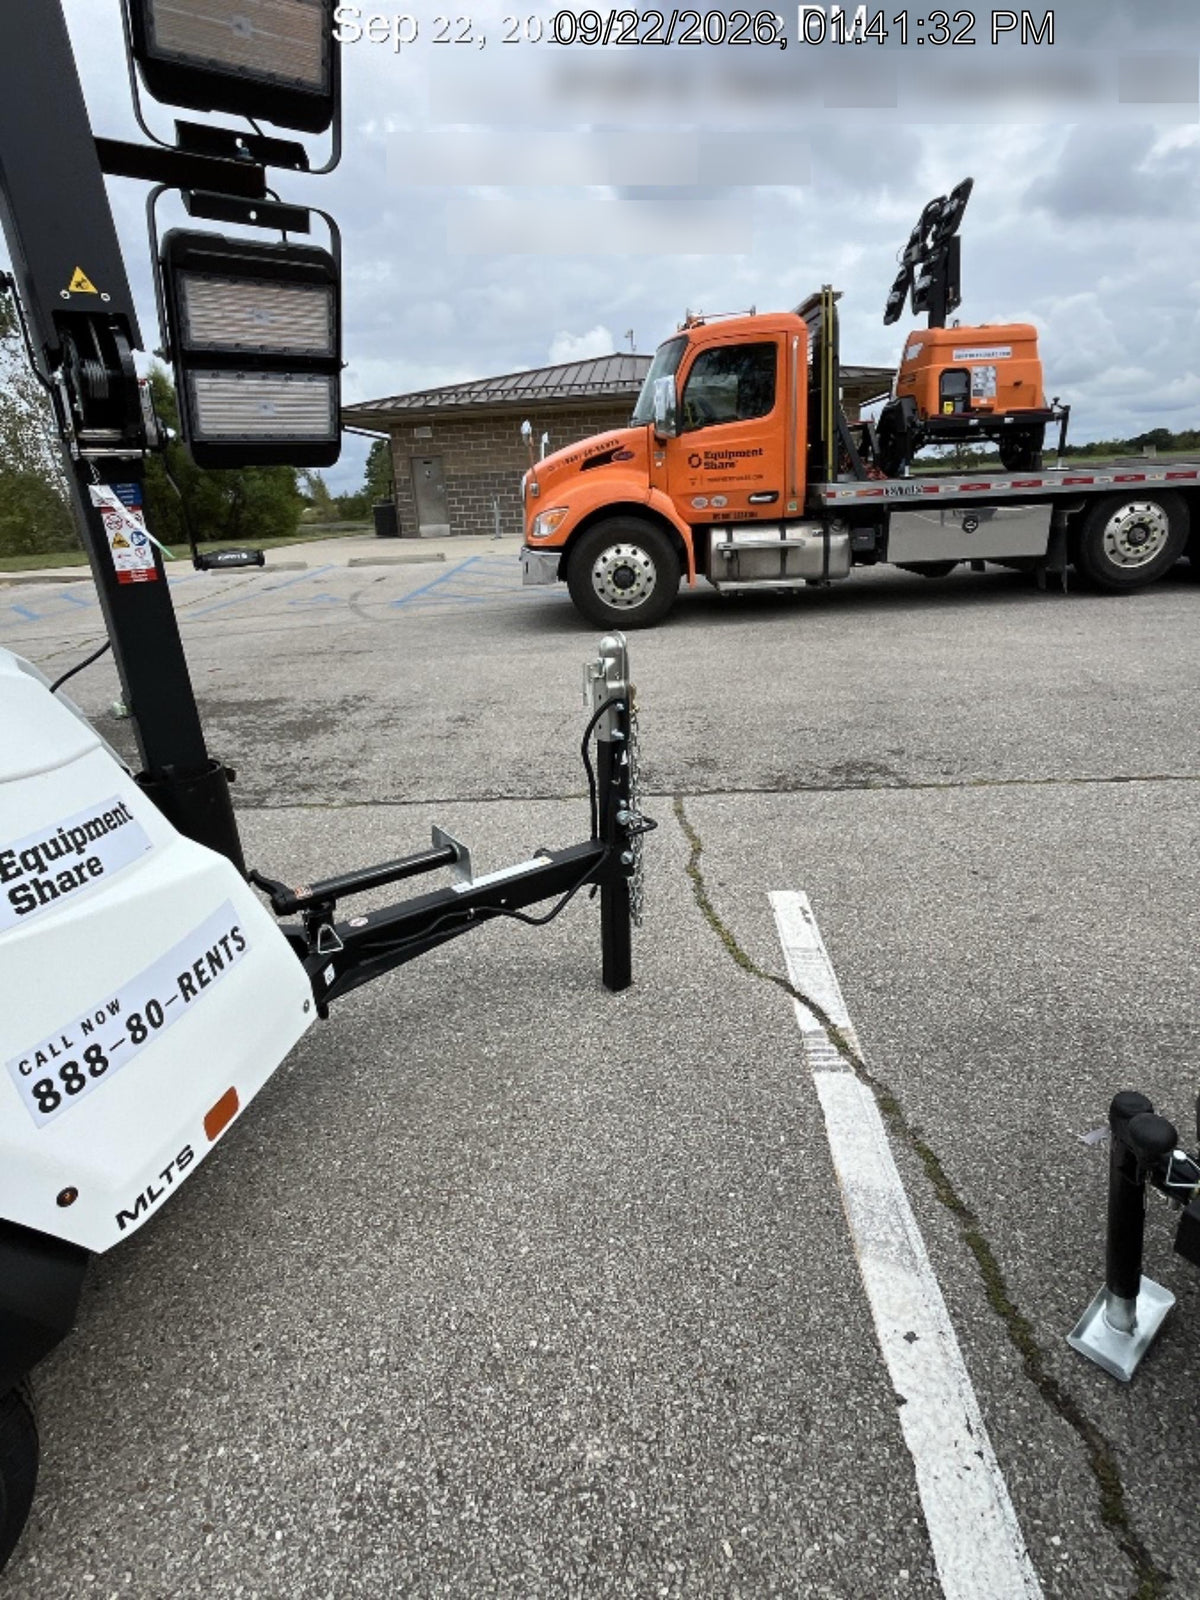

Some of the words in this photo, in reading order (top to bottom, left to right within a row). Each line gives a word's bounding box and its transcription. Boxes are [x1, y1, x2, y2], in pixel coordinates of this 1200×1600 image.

[703, 448, 764, 460] Equipment
[703, 461, 736, 470] Share
[0, 801, 134, 884] Equipment
[8, 856, 104, 916] Share
[18, 1035, 74, 1076] CALL
[80, 998, 121, 1036] NOW
[31, 926, 247, 1113] 888-80-RENTS
[115, 1144, 194, 1231] MLTS
